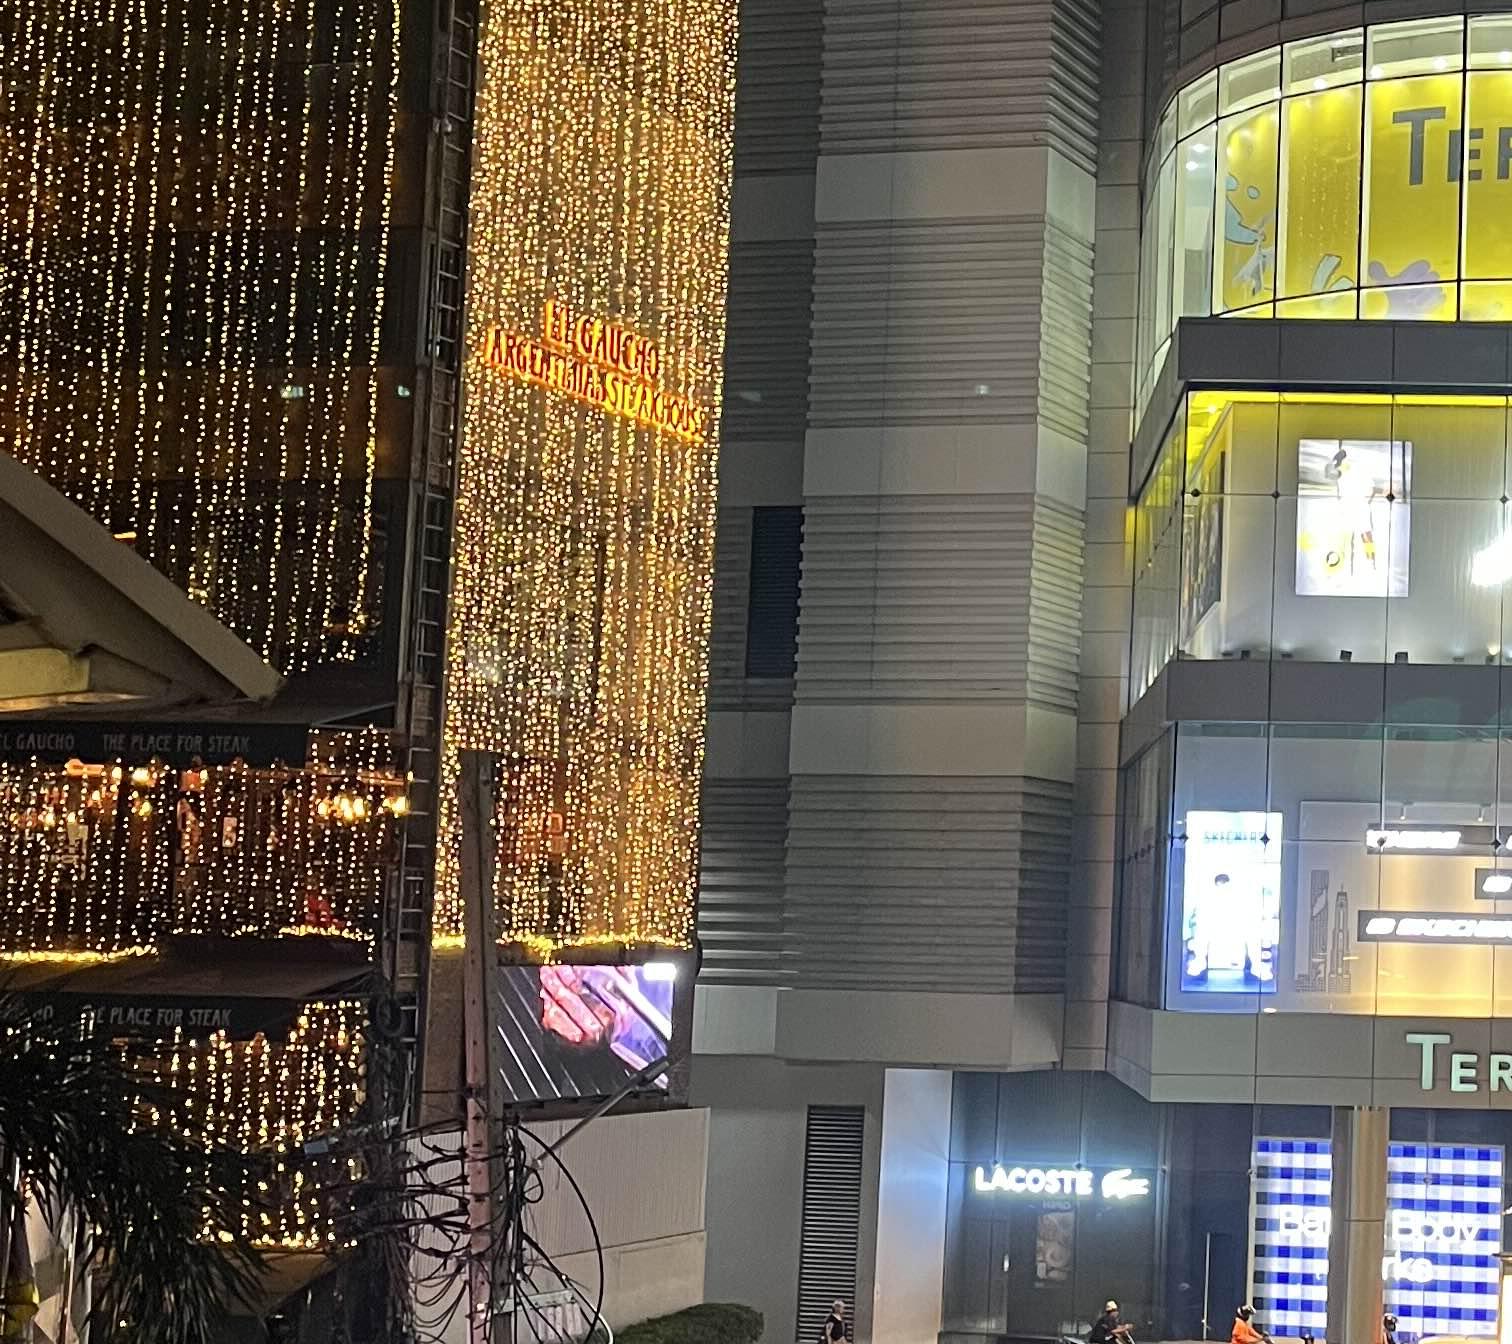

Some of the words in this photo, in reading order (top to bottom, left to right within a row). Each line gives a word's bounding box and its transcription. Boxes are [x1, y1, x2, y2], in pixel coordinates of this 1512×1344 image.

[604, 371, 705, 440] STEAKHOUS
[16, 732, 76, 752] GAUCHO
[102, 733, 125, 751] THE
[130, 735, 173, 752] PLACE
[176, 736, 202, 753] FOR
[207, 736, 251, 753] STEAK
[110, 1007, 152, 1026] PLACE
[156, 1008, 184, 1026] FOR
[187, 1008, 231, 1027] STEAK
[974, 1165, 1094, 1196] LACOSTE
